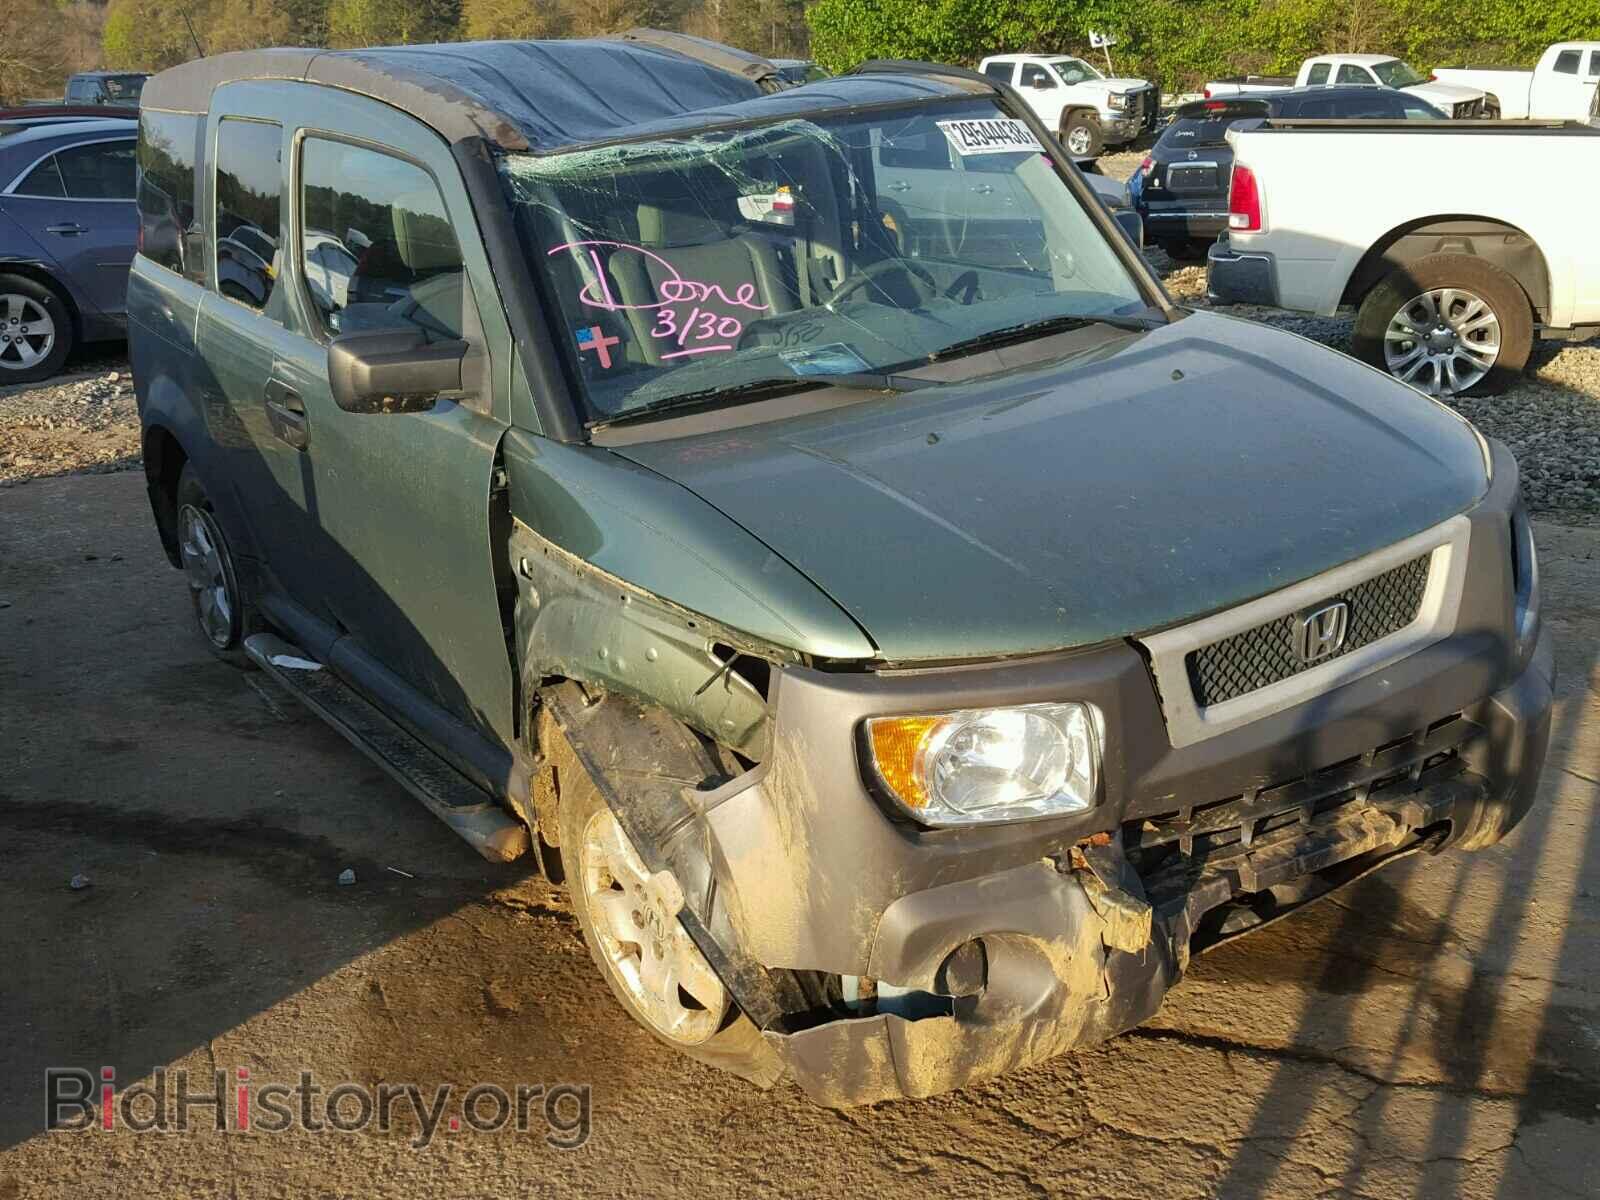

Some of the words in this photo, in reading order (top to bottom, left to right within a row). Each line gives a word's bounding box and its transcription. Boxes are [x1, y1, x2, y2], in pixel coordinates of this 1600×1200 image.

[951, 120, 1031, 147] 29544438
[547, 240, 769, 311] Done
[650, 307, 743, 346] 3/30
